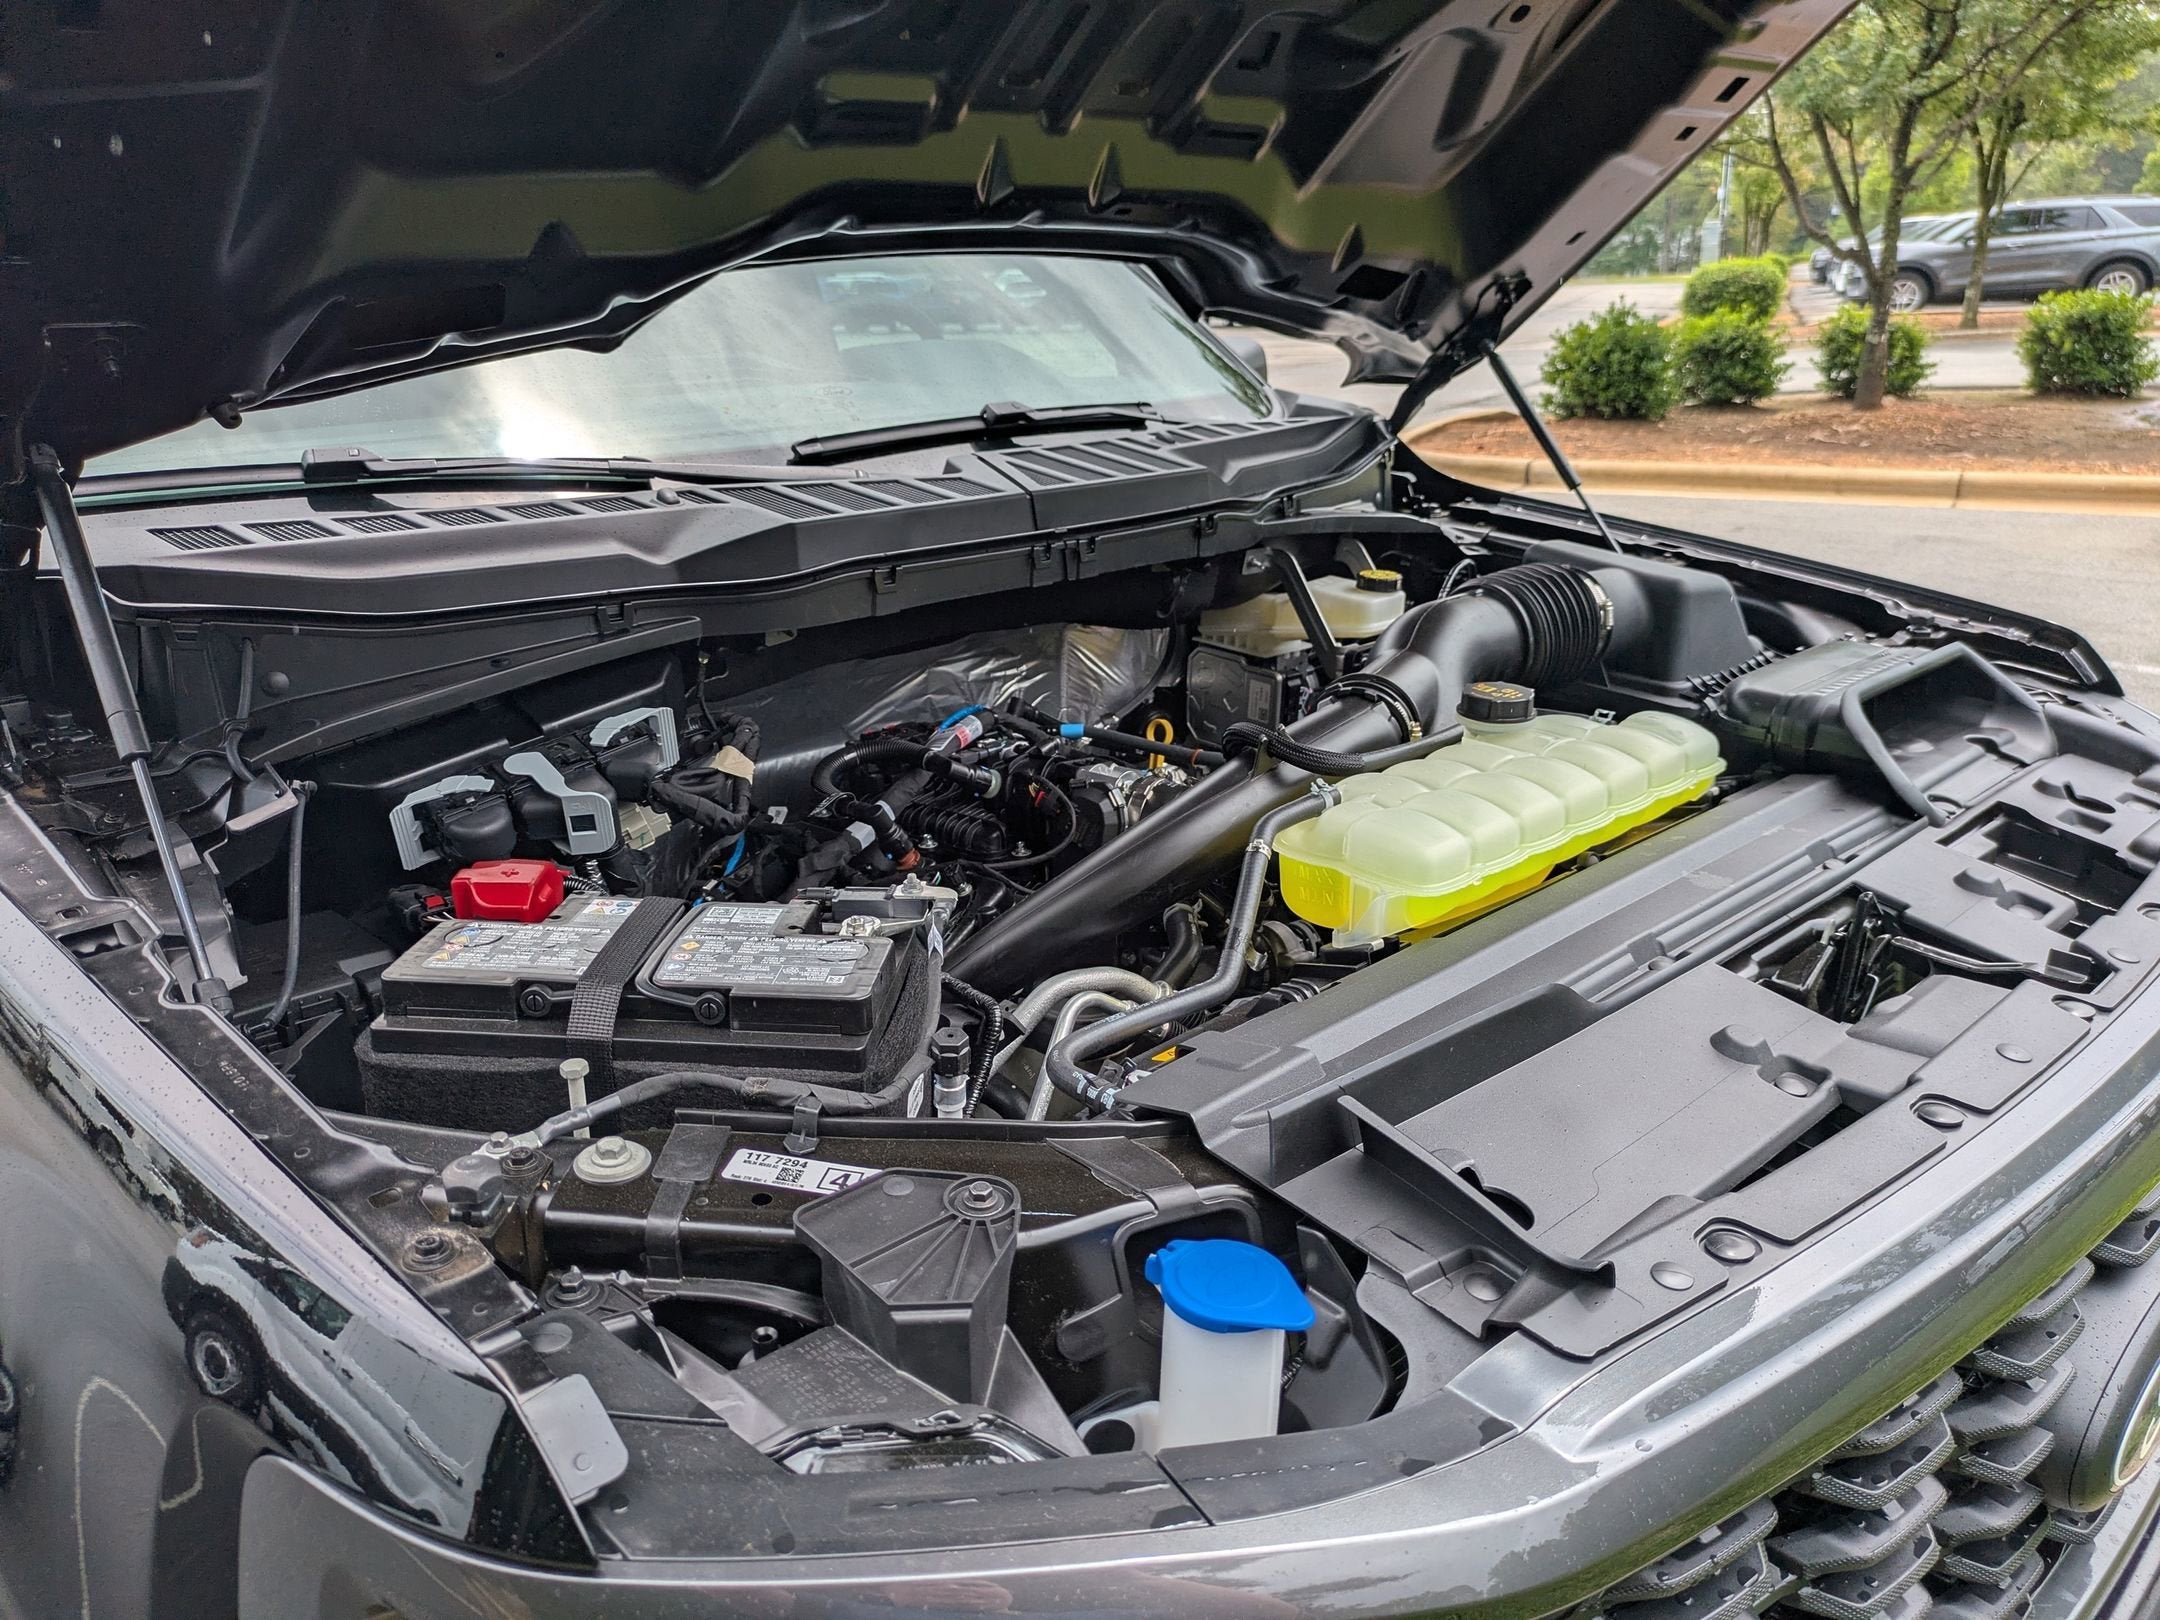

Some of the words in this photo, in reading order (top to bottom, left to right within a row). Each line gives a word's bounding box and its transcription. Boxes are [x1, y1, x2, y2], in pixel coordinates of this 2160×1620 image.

[1299, 865, 1334, 885] MAX
[1299, 886, 1333, 905] MIN
[746, 1152, 771, 1162] 117
[776, 1157, 809, 1169] 7294
[828, 1173, 852, 1190] 4
